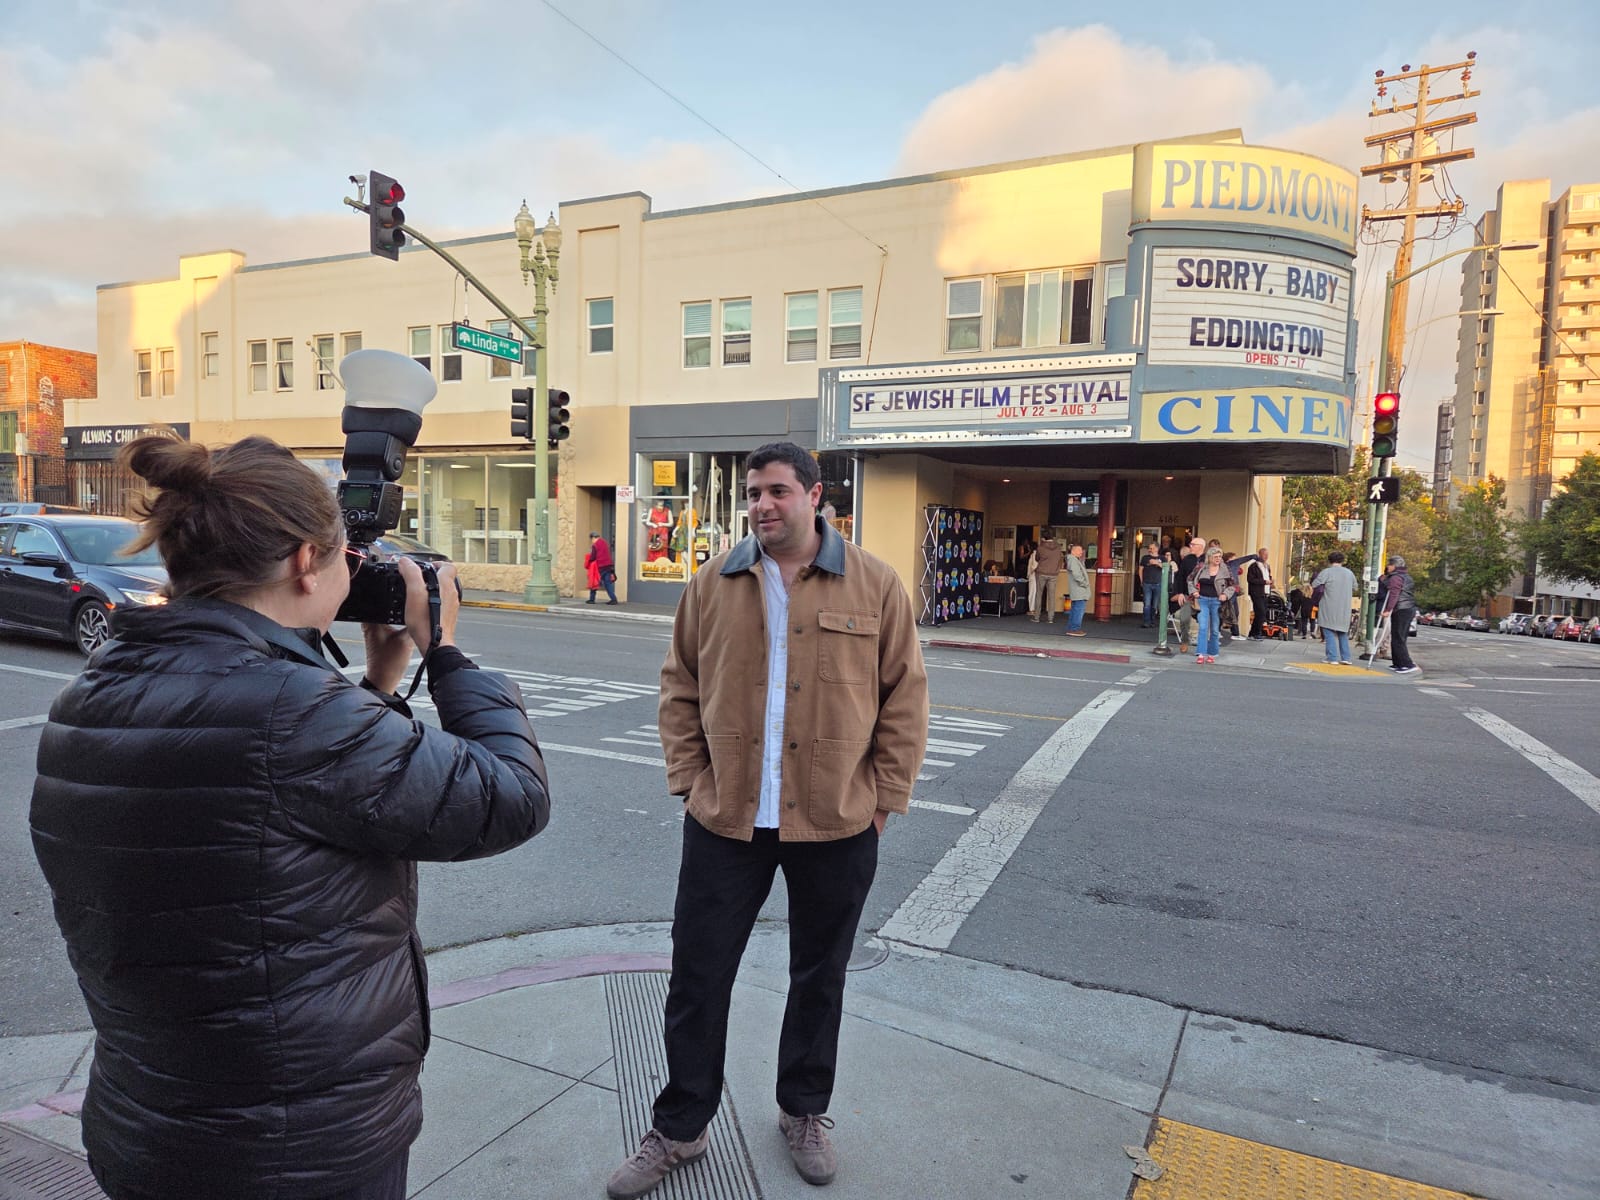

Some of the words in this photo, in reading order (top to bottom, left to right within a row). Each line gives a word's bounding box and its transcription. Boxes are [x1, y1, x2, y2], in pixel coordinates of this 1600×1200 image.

[1161, 159, 1353, 232] PIEDMONT
[1286, 265, 1339, 304] BABY
[472, 333, 498, 351] Linda
[1190, 317, 1323, 357] EDDINGTON
[1245, 351, 1279, 366] OPENS
[1283, 356, 1306, 369] 7-17
[852, 393, 875, 412] SF
[881, 388, 955, 411] JEWISH
[960, 386, 1011, 408] FILM
[1019, 380, 1129, 406] FESTIVAL
[997, 406, 1028, 418] JULY
[1032, 406, 1045, 417] 22
[1061, 404, 1084, 416] AUG
[1090, 403, 1097, 415] 3
[81, 429, 112, 445] ALWAYS
